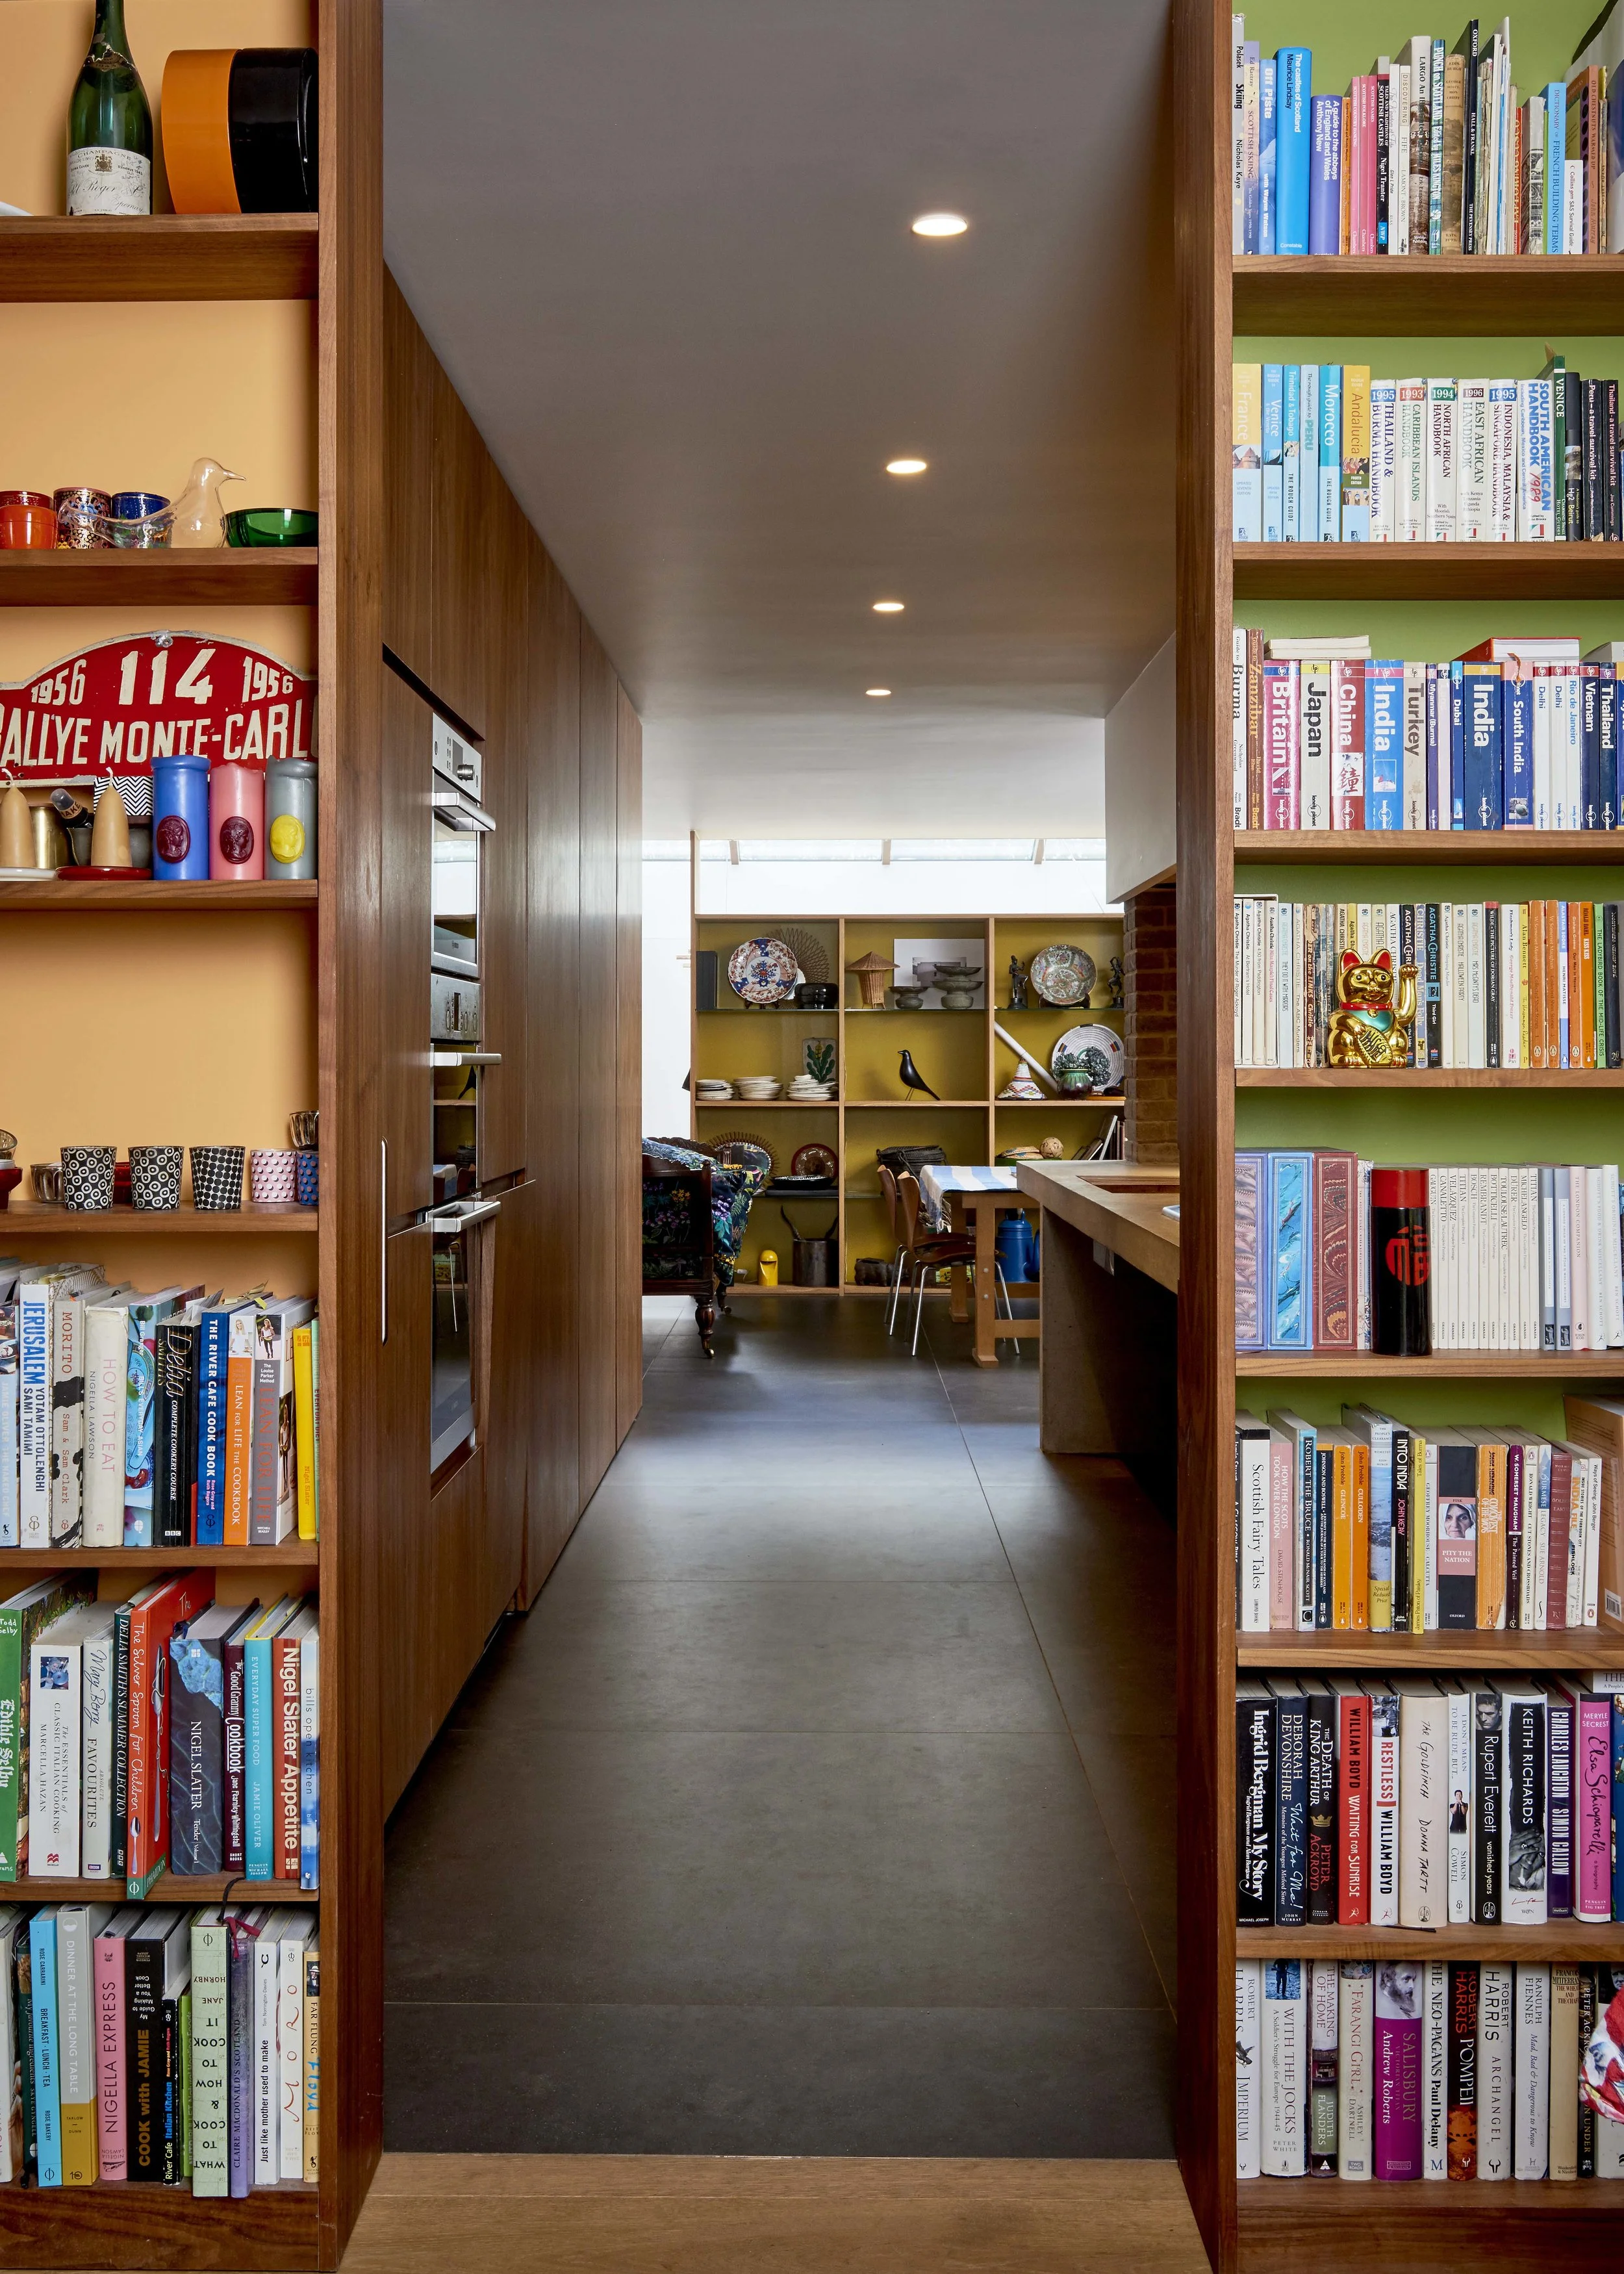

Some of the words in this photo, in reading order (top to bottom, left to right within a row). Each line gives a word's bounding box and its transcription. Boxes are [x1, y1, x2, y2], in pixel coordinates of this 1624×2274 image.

[1235, 84, 1244, 109] Skiing
[78, 149, 131, 160] CHAMPAGNE
[1325, 385, 1338, 446] Morocco
[1351, 393, 1364, 454] Andalucía
[1529, 383, 1540, 466] HANDBOOK
[1540, 383, 1549, 431] SOUTH
[1412, 404, 1421, 458] CARIBBEAN
[1540, 435, 1551, 511] AMERICAN
[31, 659, 87, 705] 1956
[119, 648, 216, 705] 114
[242, 656, 294, 703] 1956
[1273, 682, 1291, 763] Britain
[1304, 682, 1326, 757] Japan
[1339, 684, 1356, 745] China
[1375, 685, 1395, 751] India
[1405, 683, 1424, 756] Turkey
[1474, 685, 1494, 747] India
[1586, 682, 1595, 732] Vietnam
[1602, 684, 1613, 748] Thailand
[23, 1301, 45, 1385] JERUSALEM
[62, 1312, 72, 1373] MORITO
[209, 1320, 218, 1340] THE
[103, 1359, 116, 1402] HOW
[166, 1328, 192, 1397] Delia
[209, 1344, 218, 1377] RIVER
[35, 1388, 44, 1422] YOTAM
[208, 1381, 217, 1407] CAFE
[235, 1385, 243, 1409] LEAN
[103, 1411, 116, 1434] TO
[207, 1412, 216, 1441] COOK
[234, 1429, 242, 1448] LIFE
[36, 1427, 45, 1492] OTTOLENGHI
[101, 1444, 116, 1472] EAT
[207, 1446, 216, 1476] BOOK
[1397, 1439, 1407, 1463] INTO
[233, 1467, 242, 1524] COOKBOOK
[1252, 1464, 1264, 1514] Scottish
[1397, 1466, 1407, 1489] INDIA
[1249, 1520, 1264, 1552] Fairy
[1252, 1557, 1264, 1589] Tales
[84, 1650, 107, 1693] Mary
[280, 1648, 299, 1696] Nigel
[84, 1691, 106, 1729] Berry
[305, 1688, 314, 1713] bills
[191, 1721, 201, 1760] NIGEL
[284, 1702, 300, 1758] Slater
[302, 1718, 312, 1747] open
[1249, 1709, 1269, 1756] Ingrid
[1523, 1709, 1533, 1748] KEITH
[304, 1752, 314, 1795] kitchen
[1380, 1742, 1393, 1799] RESTLESS
[1480, 1736, 1498, 1780] Rupert
[86, 1737, 97, 1828] FAVOURITES
[191, 1763, 201, 1809] SLATER
[1249, 1759, 1268, 1828] Bergman
[1523, 1754, 1533, 1824] RICHARDS
[281, 1763, 300, 1849] Appetite
[1484, 1786, 1498, 1833] Everett
[1552, 1809, 1569, 1837] SIMON
[1249, 1833, 1267, 1857] My
[1380, 1810, 1393, 1860] WILLIAM
[1239, 1859, 1267, 1900] Story
[1380, 1864, 1392, 1894] BOYD
[1552, 1842, 1569, 1874] CALLOW
[66, 1941, 75, 1980] DINNER
[68, 1984, 76, 1998] AT
[68, 2002, 76, 2023] THE
[41, 2008, 49, 2044] BREAKFAST
[102, 1982, 117, 2052] EXPRESS
[207, 2018, 218, 2026] IT
[42, 2049, 50, 2069] LUNCH
[68, 2026, 77, 2056] LONG
[138, 2030, 149, 2077] JAMIE
[194, 2038, 225, 2047] COOK
[1383, 2031, 1393, 2075] Andrew
[69, 2061, 77, 2093] TABLE
[196, 2079, 222, 2088] HOW
[307, 2056, 320, 2110] Floyd
[1402, 2033, 1416, 2123] SALISBURY
[1431, 2080, 1440, 2105] Paul
[1460, 2039, 1474, 2105] POMPEII
[104, 2061, 118, 2132] NIGELLA
[140, 2083, 149, 2115] with
[211, 2101, 218, 2109] &
[1382, 2079, 1393, 2124] Roberts
[1491, 2056, 1501, 2142] ARCHANGEL
[139, 2121, 150, 2165] COOK
[194, 2121, 225, 2129] COOK
[1428, 2108, 1441, 2149] Delany
